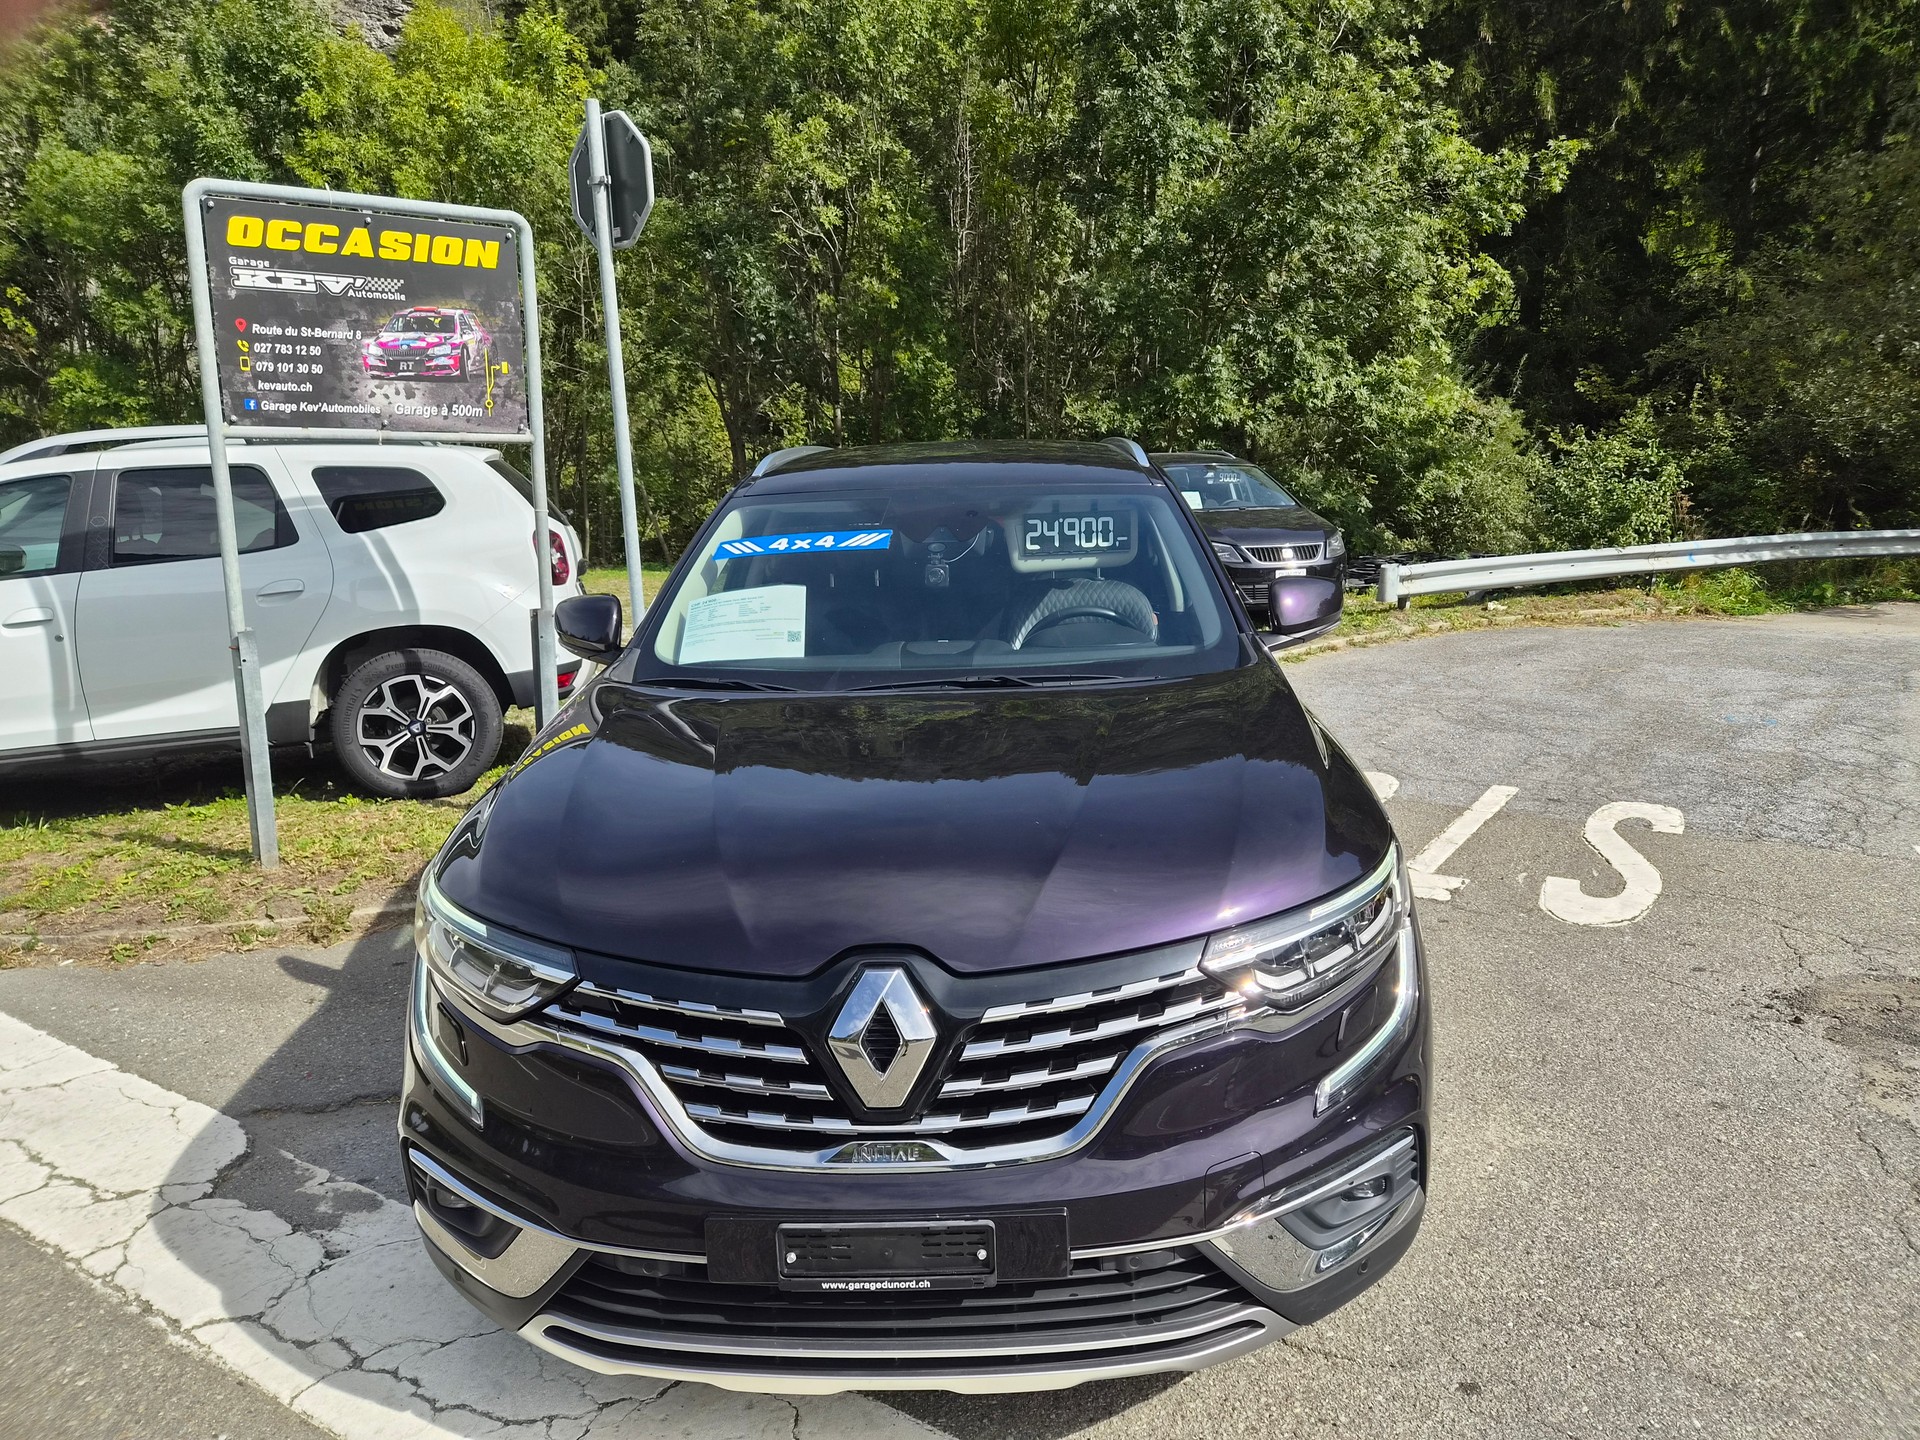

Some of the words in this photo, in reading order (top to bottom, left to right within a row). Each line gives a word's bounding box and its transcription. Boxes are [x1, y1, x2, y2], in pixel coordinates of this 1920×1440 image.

[226, 215, 500, 269] OCCASION
[228, 256, 270, 268] Garage
[348, 289, 406, 301] Automobile
[252, 323, 283, 337] Route
[285, 325, 298, 336] du
[300, 326, 354, 340] St-Bernard
[355, 330, 362, 340] 8
[253, 342, 273, 353] 027
[274, 344, 293, 354] 783
[295, 345, 306, 355] 12
[309, 345, 321, 356] 50
[256, 361, 275, 372] 079
[277, 363, 293, 373] 101
[295, 363, 308, 374] 30
[310, 364, 323, 374] 50
[399, 361, 414, 371] RT
[258, 380, 312, 392] kevauto.ch
[261, 401, 298, 414] Garage
[300, 402, 381, 415] Kev'Automobiles
[394, 402, 439, 416] Garage
[441, 403, 450, 416] à
[452, 405, 483, 417] 500m
[768, 535, 835, 551] 4x4
[821, 1279, 931, 1290] www.garagedunord.ch
